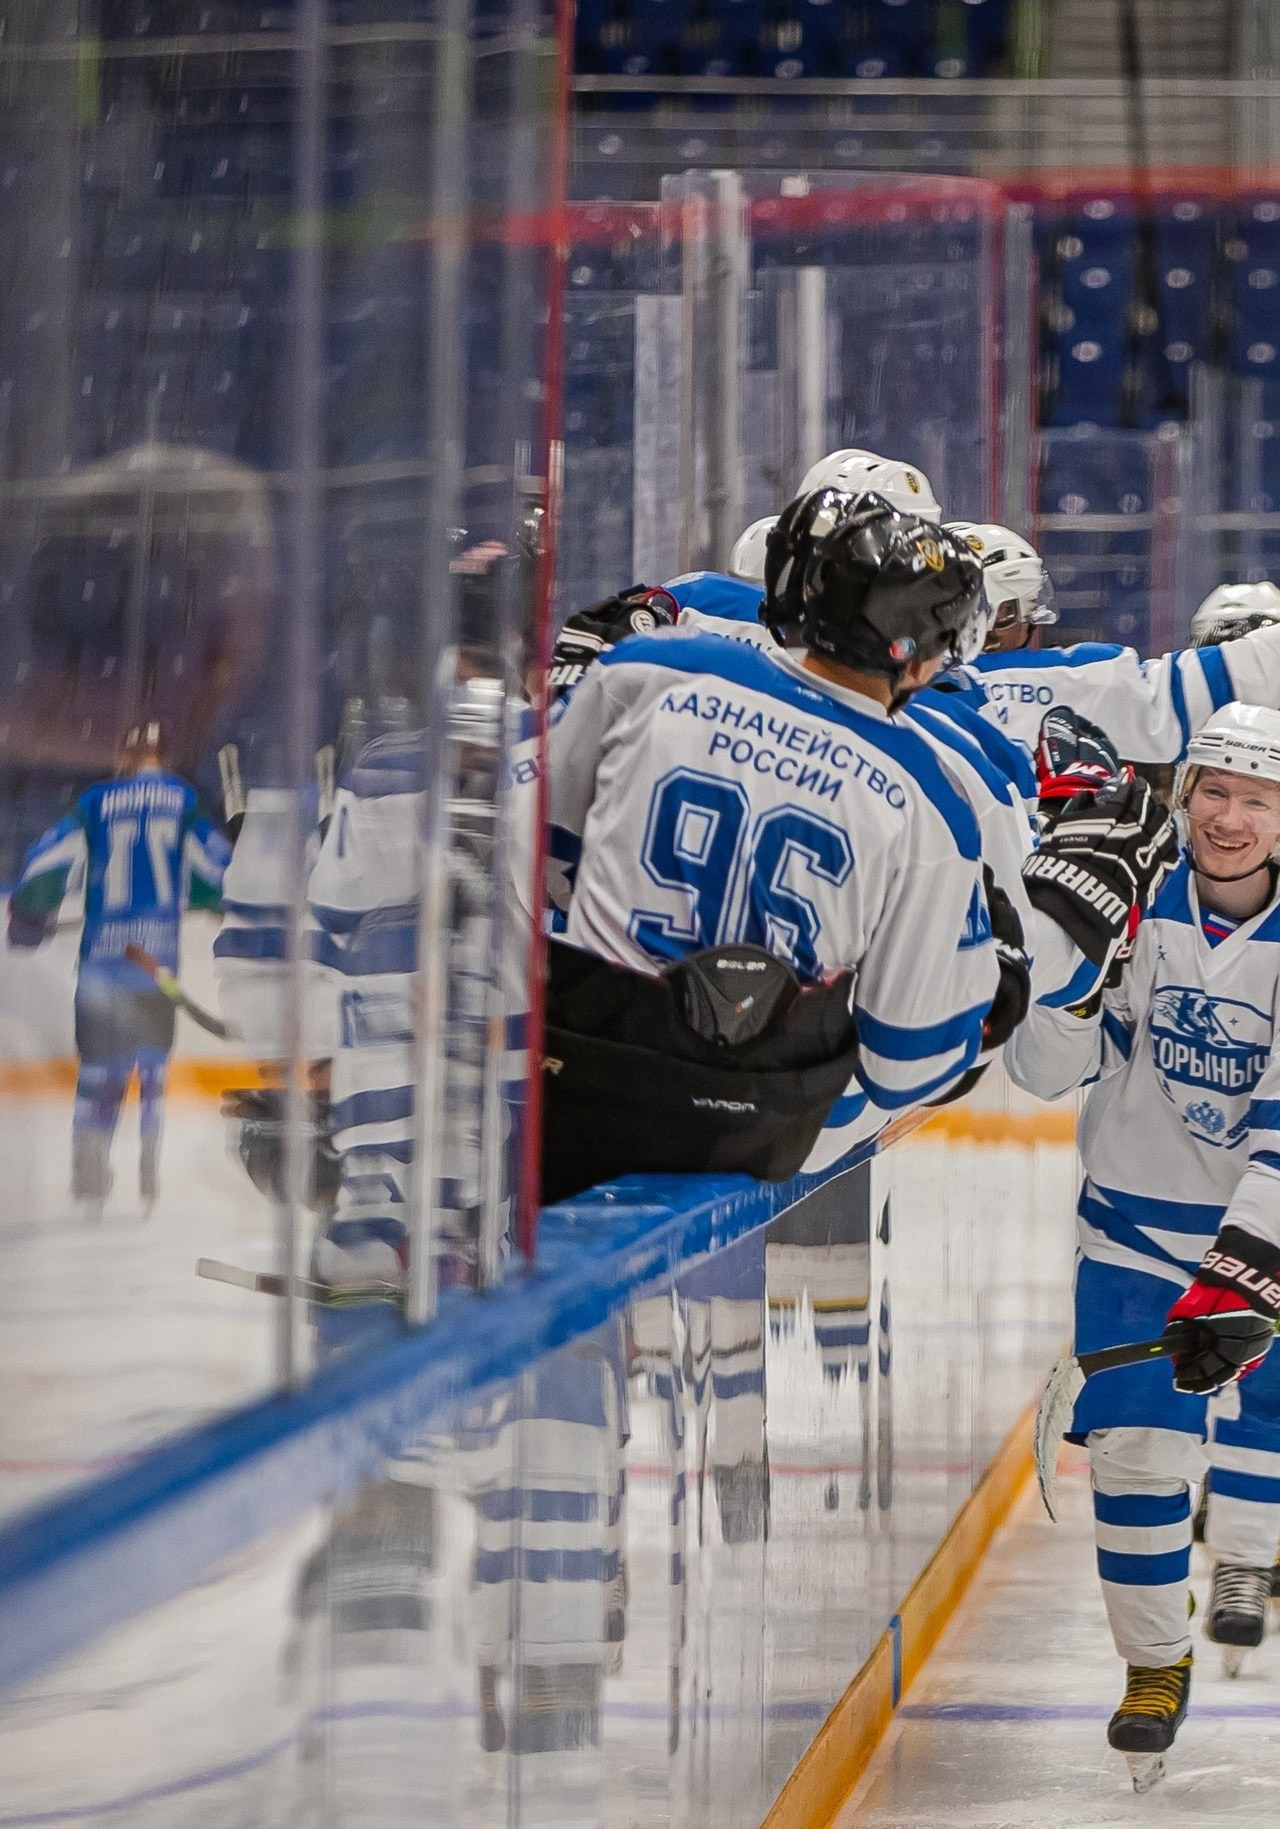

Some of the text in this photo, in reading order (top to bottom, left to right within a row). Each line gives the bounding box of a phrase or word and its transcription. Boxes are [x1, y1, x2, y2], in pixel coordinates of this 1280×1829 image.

[659, 692, 907, 810] КАЗНАЧЕЙСТВО
[708, 730, 844, 803] РОССИИ
[1225, 739, 1267, 753] BAUER
[626, 764, 855, 985] 96
